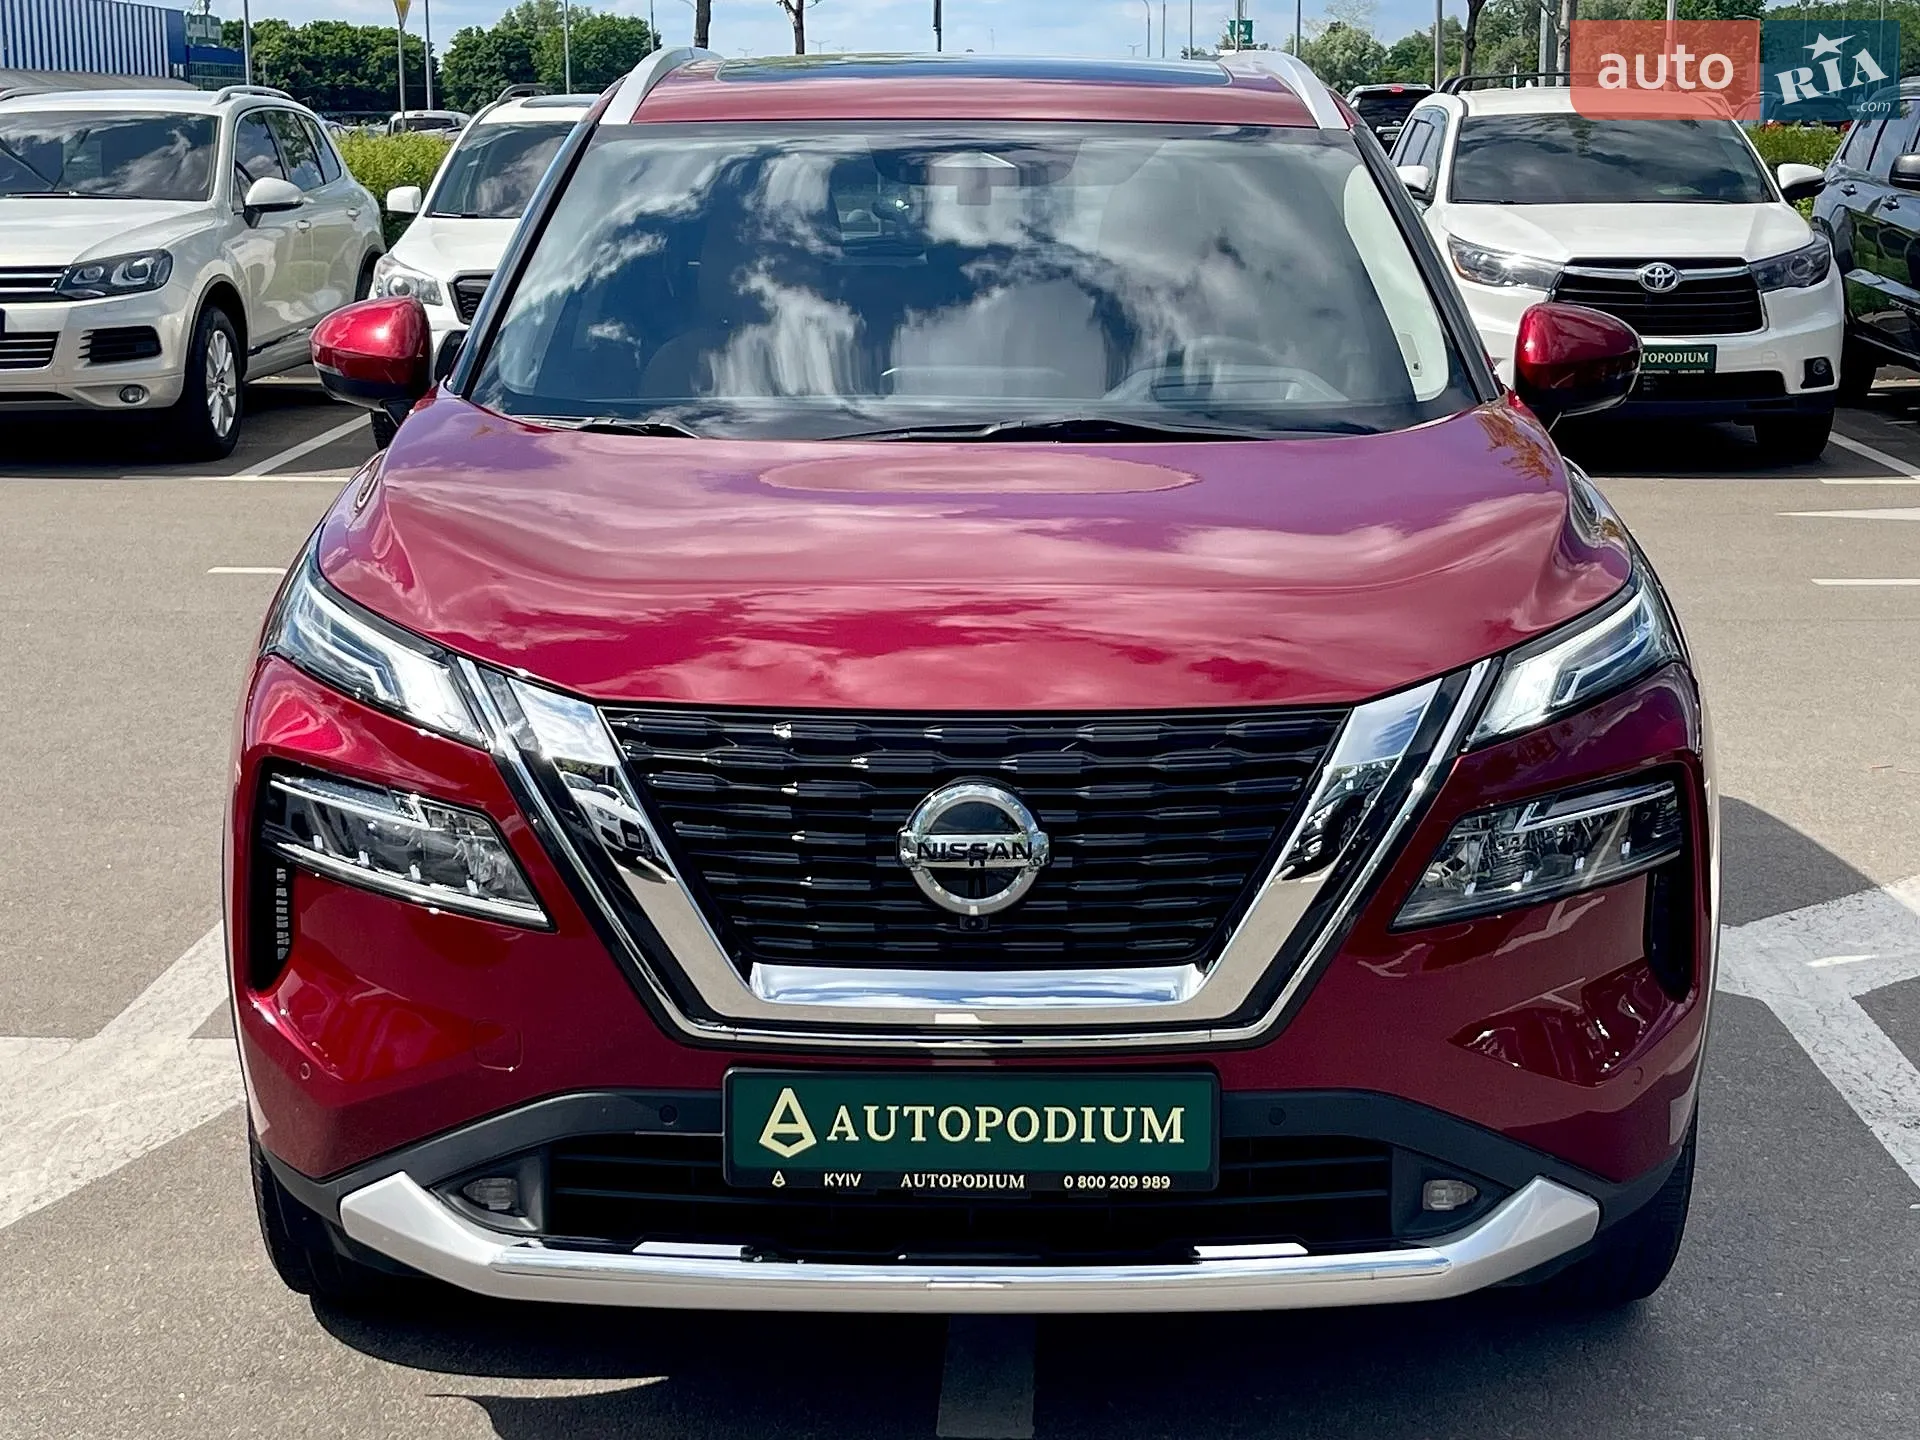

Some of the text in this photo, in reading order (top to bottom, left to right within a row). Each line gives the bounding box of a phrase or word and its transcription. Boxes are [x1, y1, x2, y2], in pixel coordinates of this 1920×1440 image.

[916, 842, 1033, 860] NISSAN
[826, 1104, 1185, 1144] AUTOPODIUM
[823, 1172, 1171, 1189] KYIV AUTOPODIUM 0 800 209 989
